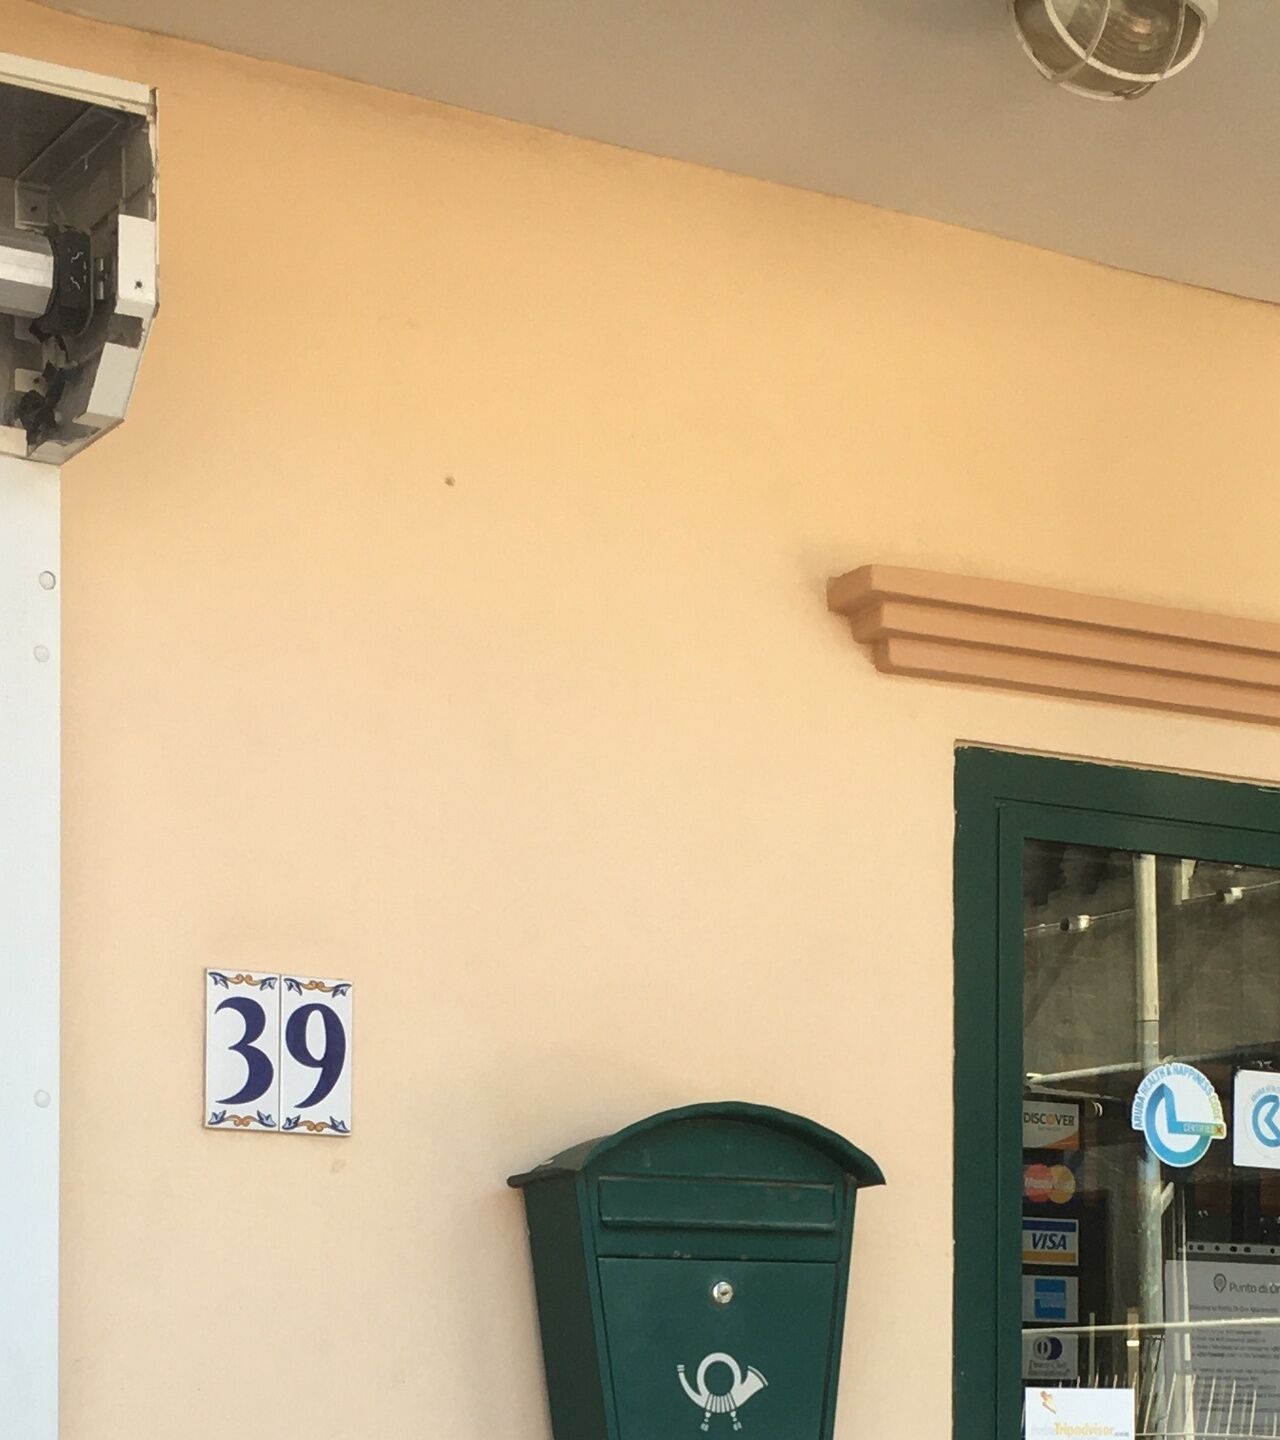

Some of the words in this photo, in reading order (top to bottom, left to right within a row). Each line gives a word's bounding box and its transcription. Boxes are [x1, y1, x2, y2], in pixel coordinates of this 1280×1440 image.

[214, 996, 347, 1109] 39
[1133, 1096, 1145, 1128] ARUBA
[1140, 1067, 1166, 1096] HEALTH
[1172, 1065, 1214, 1097] HAPPINESS
[1023, 1112, 1075, 1127] DISCOVER
[1031, 1232, 1068, 1250] VISA
[1228, 1282, 1257, 1293] Punto
